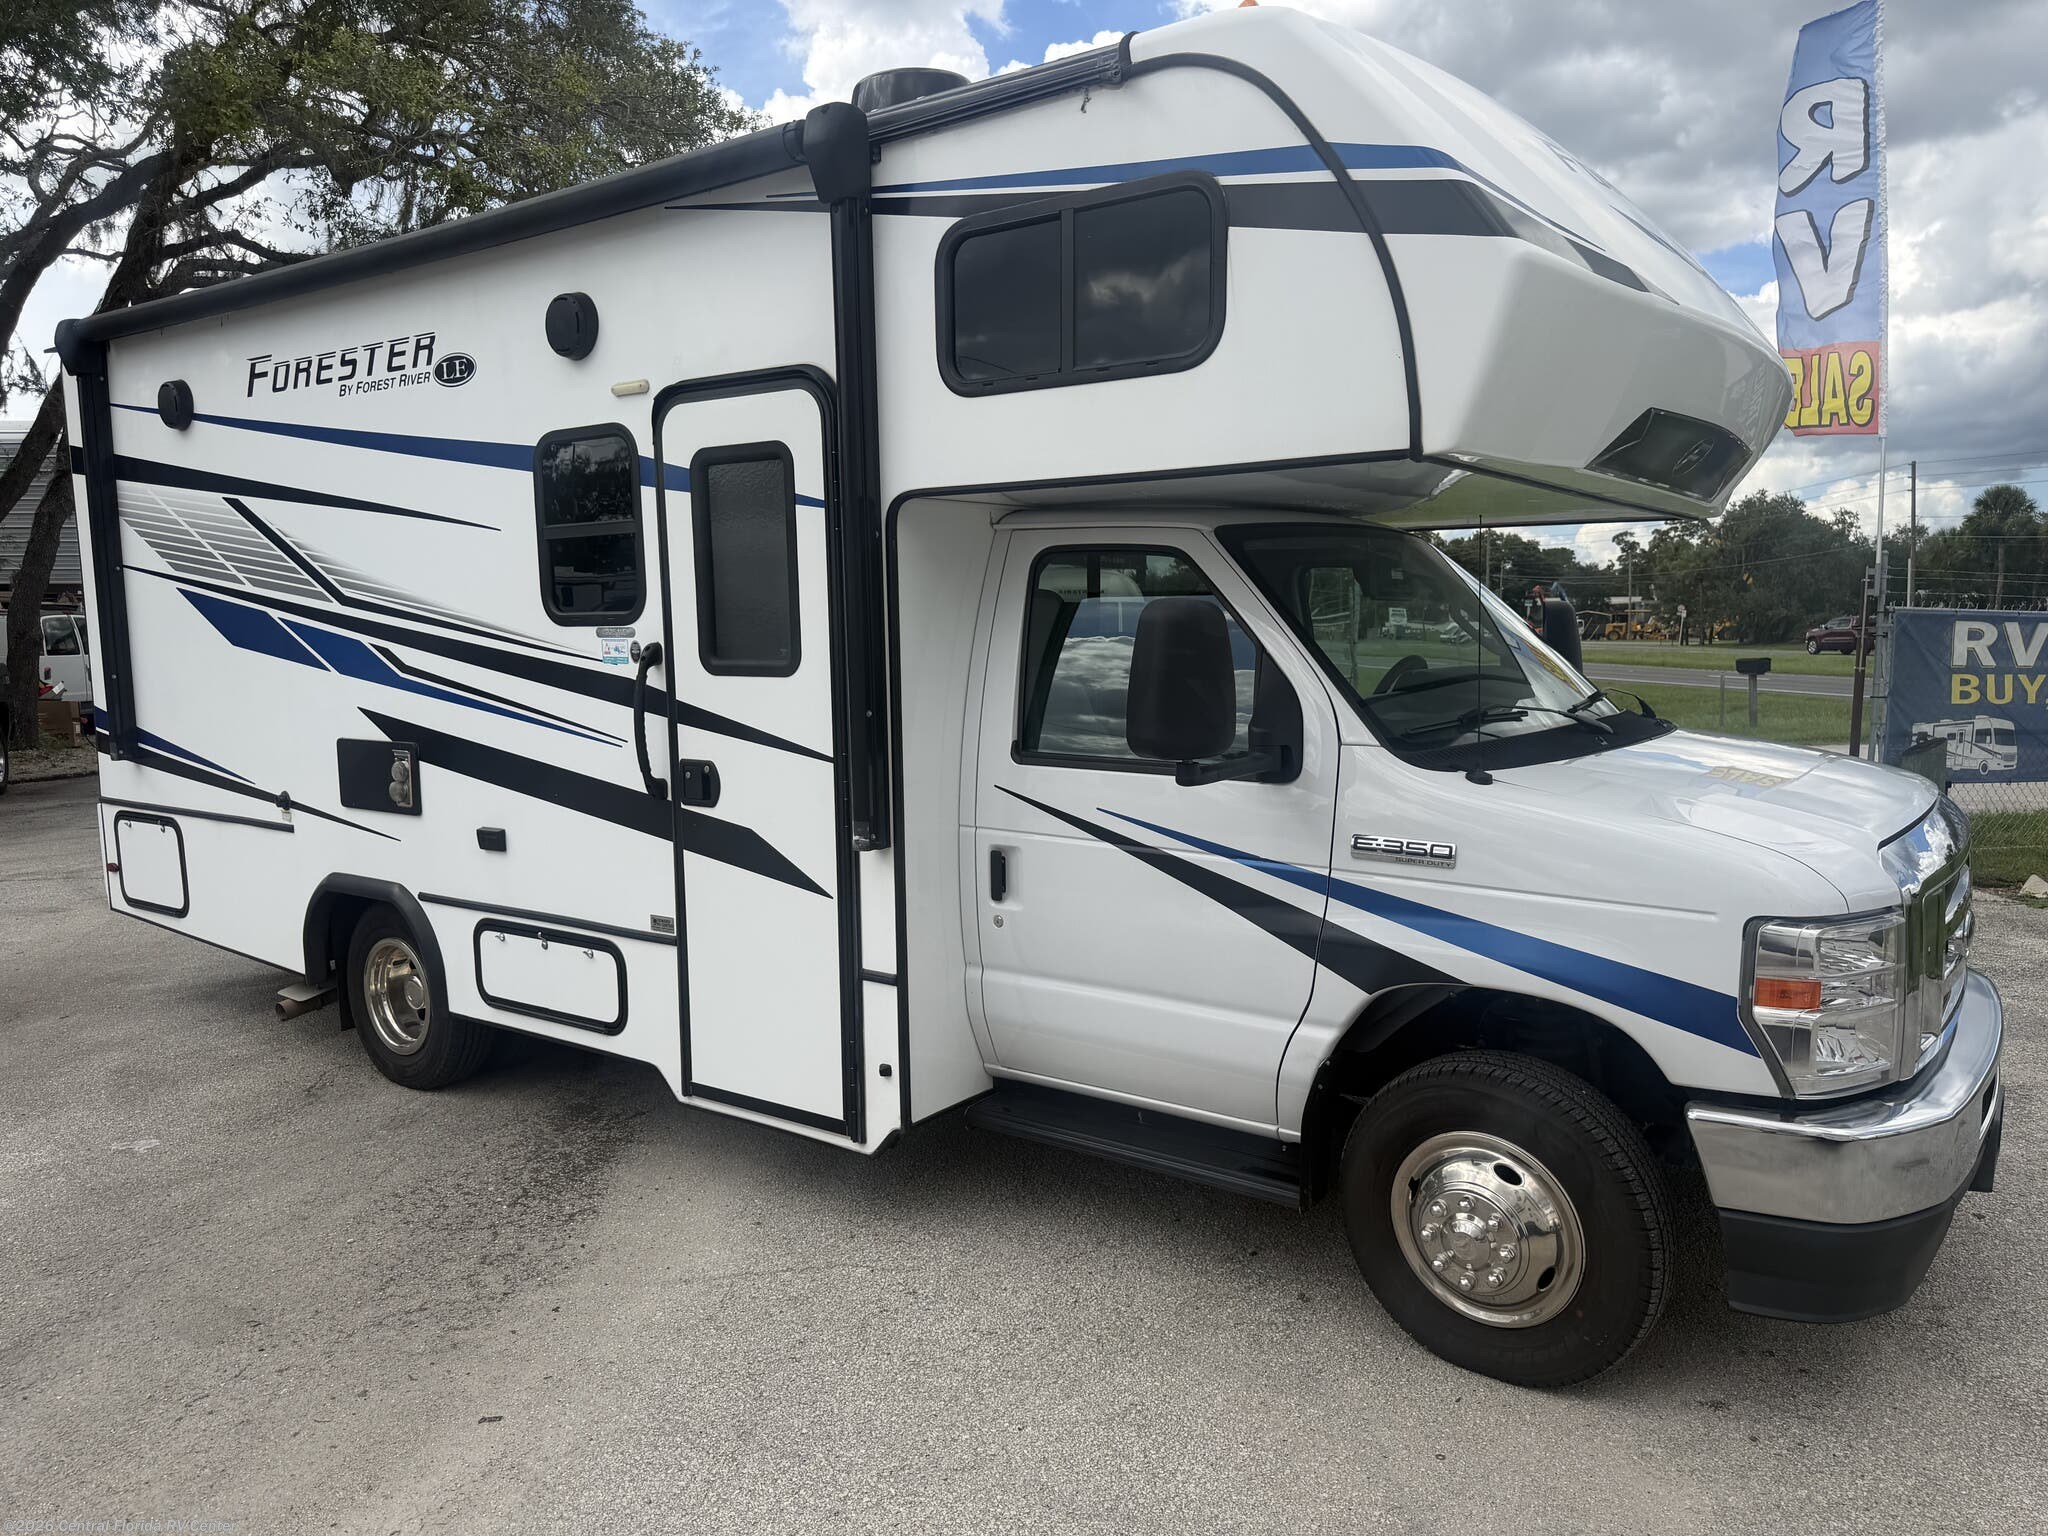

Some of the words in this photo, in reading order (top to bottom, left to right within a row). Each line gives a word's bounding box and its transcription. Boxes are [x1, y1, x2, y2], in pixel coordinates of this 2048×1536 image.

[246, 331, 436, 398] FORESTER
[441, 356, 469, 380] LE
[355, 377, 396, 394] FOREST
[399, 371, 431, 388] RIVER
[1951, 620, 2048, 669] RV
[1426, 859, 1452, 867] DUTY
